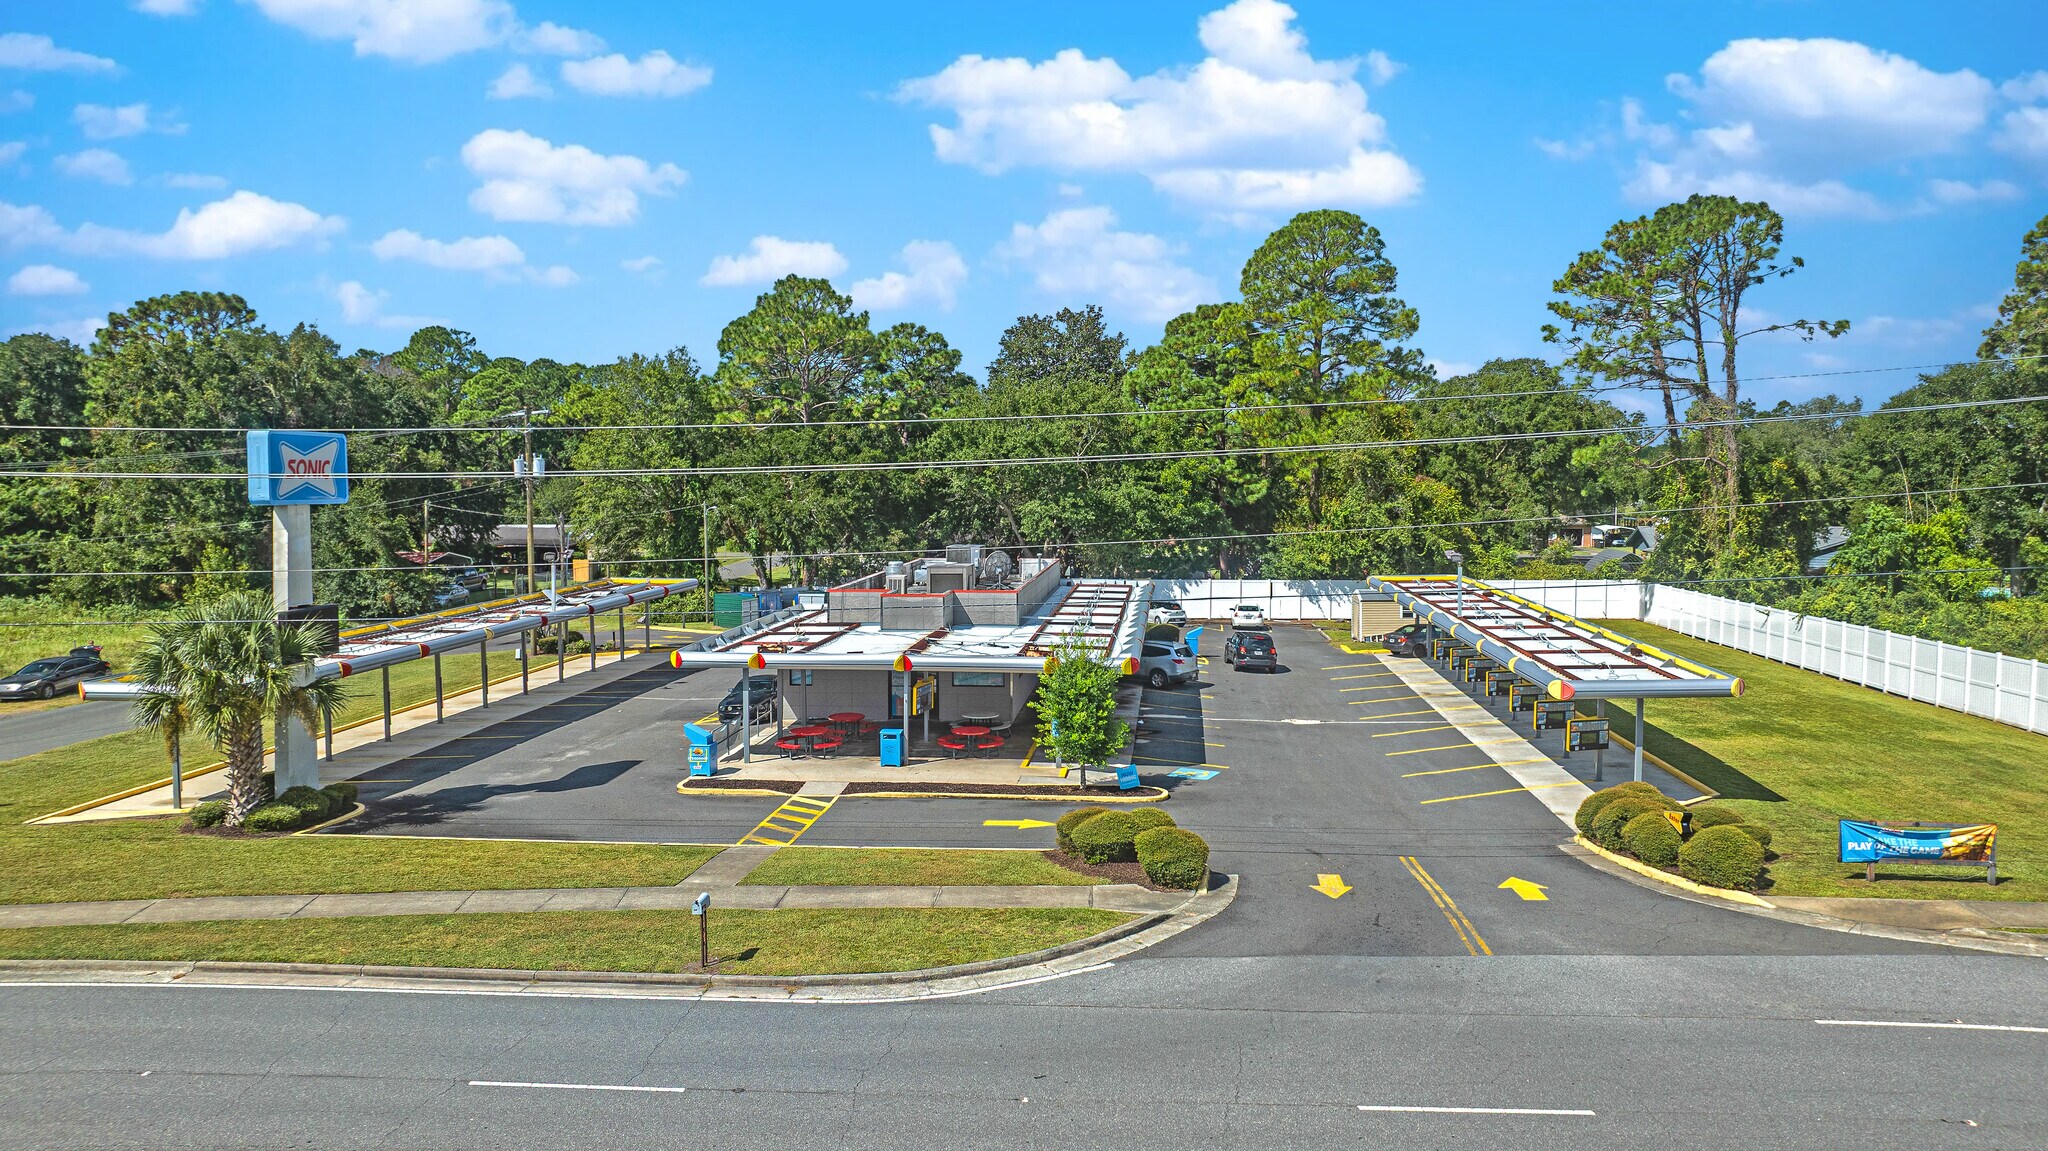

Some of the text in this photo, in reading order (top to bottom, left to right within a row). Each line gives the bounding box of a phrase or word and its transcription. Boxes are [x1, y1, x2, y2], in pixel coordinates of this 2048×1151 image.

[286, 459, 330, 479] SONIC
[1847, 841, 1873, 851] PLAY
[1910, 846, 1941, 855] GAME
[1897, 838, 1919, 847] THE
